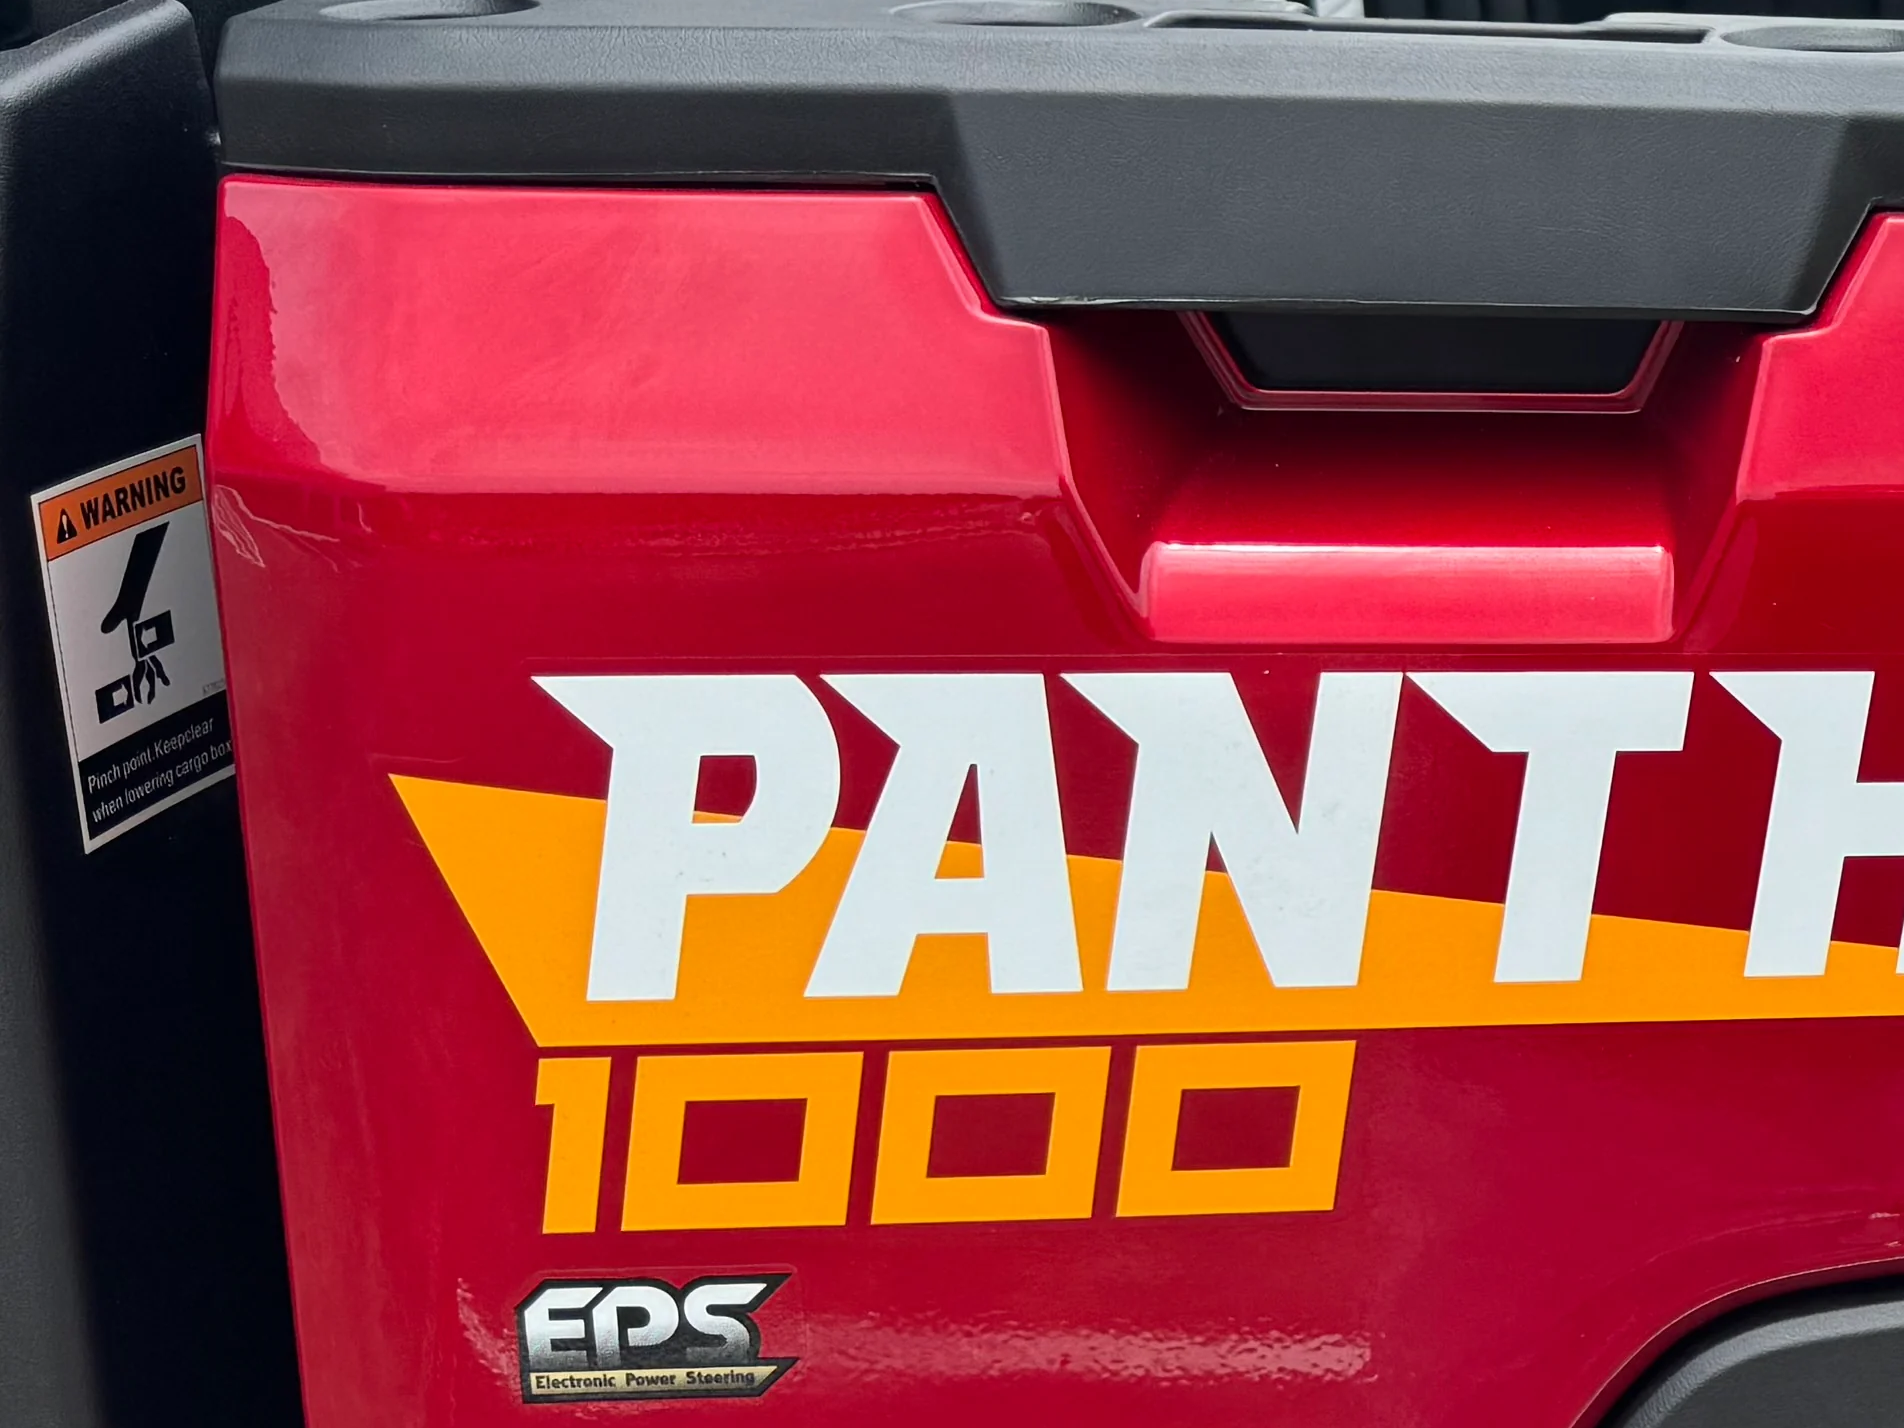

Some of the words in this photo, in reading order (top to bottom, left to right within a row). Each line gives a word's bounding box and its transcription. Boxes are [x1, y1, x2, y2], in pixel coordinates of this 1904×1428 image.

[80, 466, 187, 531] WARNING
[87, 765, 121, 794] Pinch
[92, 796, 124, 823] when
[125, 769, 174, 806] lowering
[176, 752, 209, 778] cargo
[211, 741, 232, 762] box
[536, 1041, 1356, 1233] 1000
[524, 1283, 768, 1369] EPS
[536, 1374, 616, 1389] Electronic
[625, 1373, 675, 1387] Power
[686, 1370, 755, 1385] Steering
